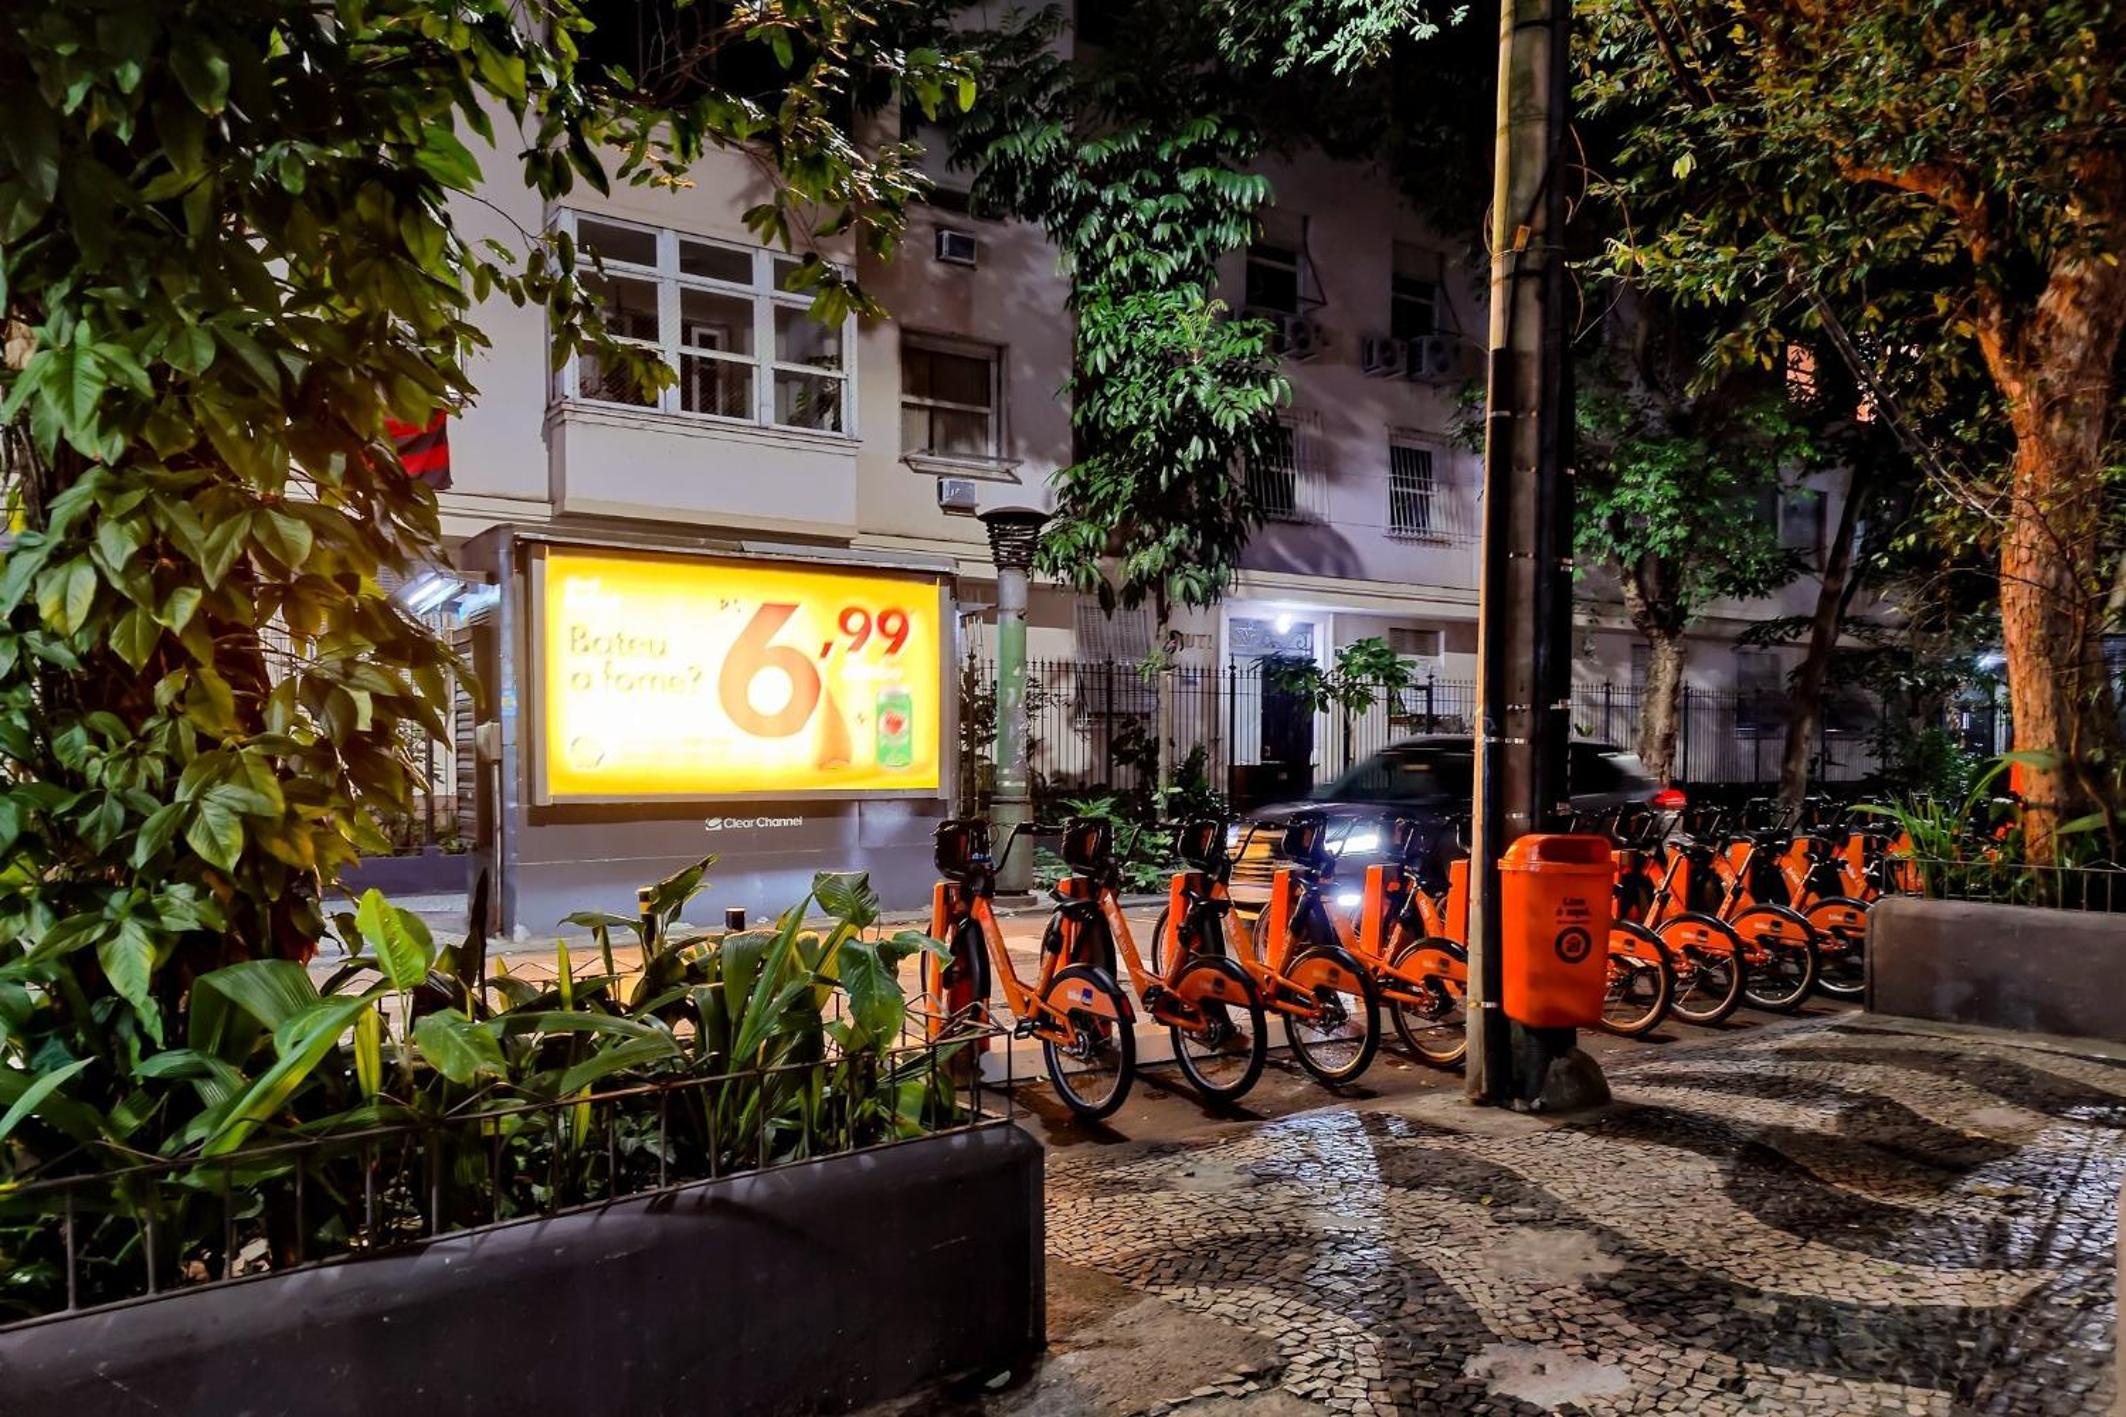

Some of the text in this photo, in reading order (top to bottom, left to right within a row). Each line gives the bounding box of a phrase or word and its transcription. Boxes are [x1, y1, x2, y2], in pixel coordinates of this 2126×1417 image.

[718, 602, 910, 738] 6,99
[723, 816, 803, 829] Clear Channel
